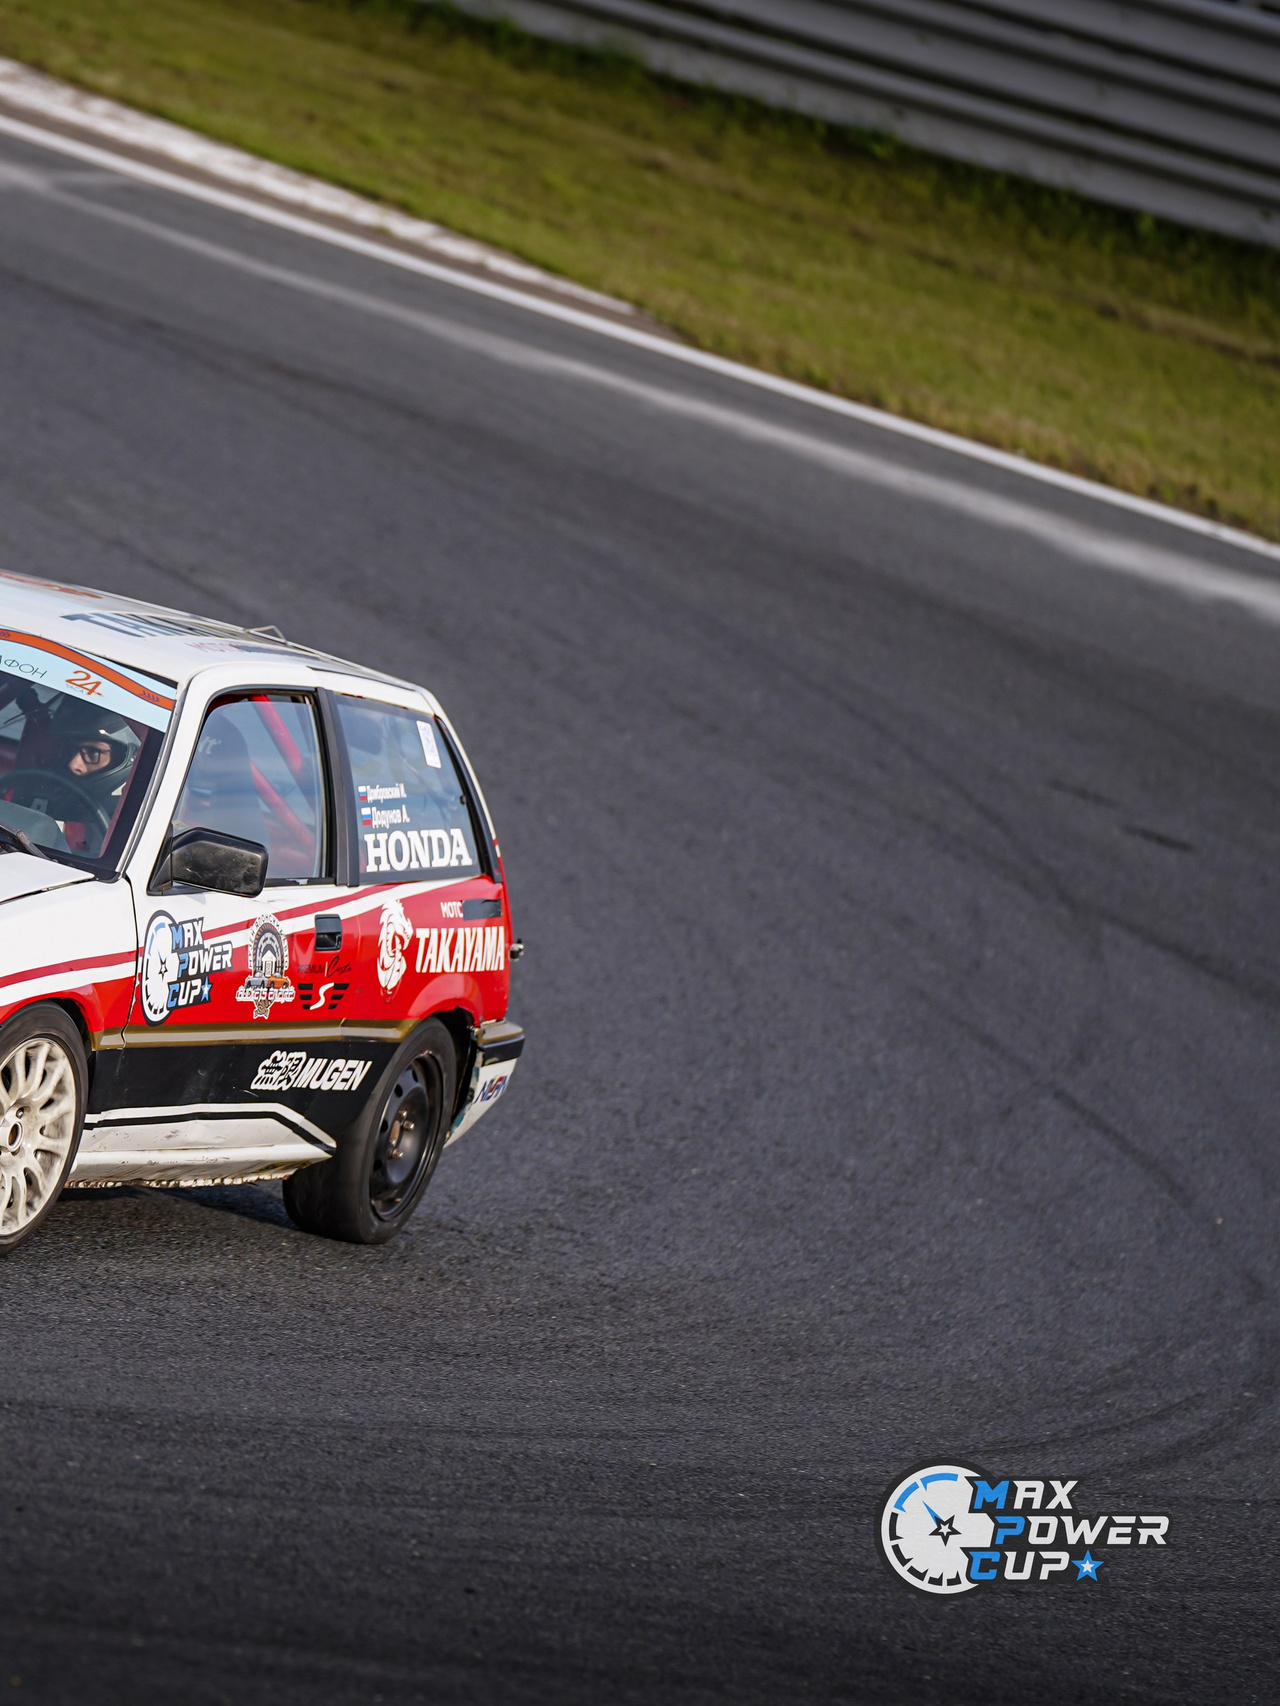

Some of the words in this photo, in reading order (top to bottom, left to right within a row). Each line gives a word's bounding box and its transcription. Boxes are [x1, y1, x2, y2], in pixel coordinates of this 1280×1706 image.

[363, 828, 473, 873] HONDA
[171, 920, 204, 950] MAX
[415, 926, 505, 973] TAKAYAMA
[179, 944, 233, 977] POWER
[168, 979, 202, 1008] CUP
[292, 1058, 373, 1091] MUGEN
